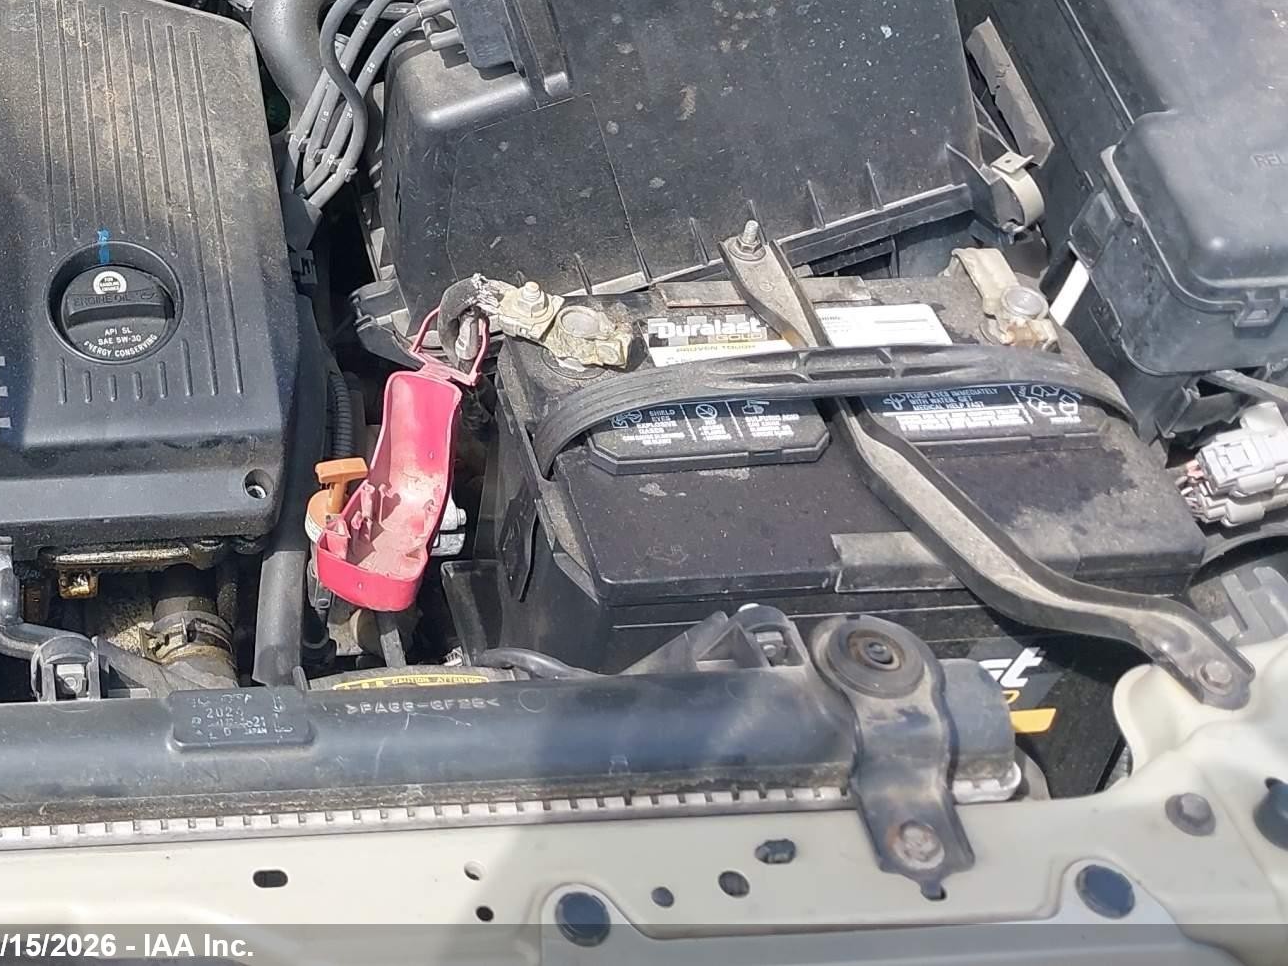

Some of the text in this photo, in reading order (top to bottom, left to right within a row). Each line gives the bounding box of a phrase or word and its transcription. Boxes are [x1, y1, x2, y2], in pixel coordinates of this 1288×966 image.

[105, 326, 133, 336] API SL
[650, 317, 762, 338] Duralast
[83, 333, 158, 358] ENERGY CONSERVING
[98, 334, 142, 346] SAE 5W-30
